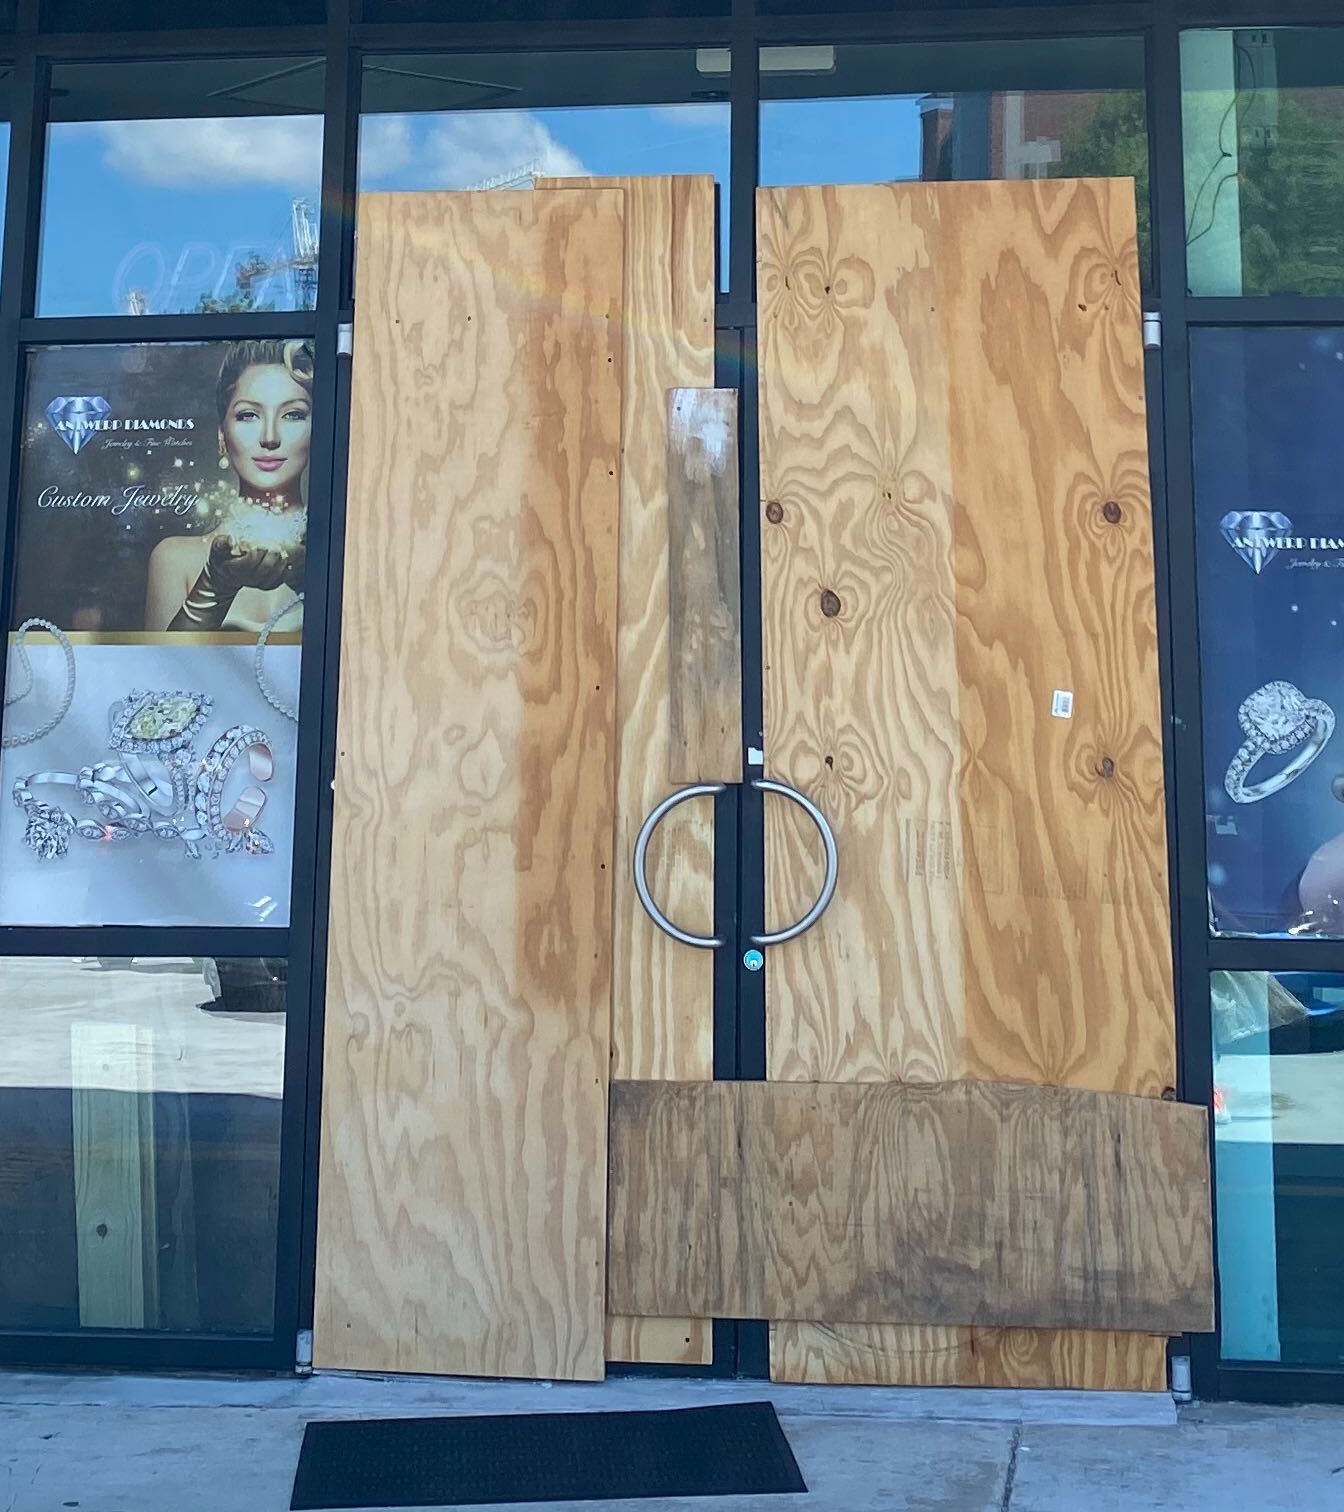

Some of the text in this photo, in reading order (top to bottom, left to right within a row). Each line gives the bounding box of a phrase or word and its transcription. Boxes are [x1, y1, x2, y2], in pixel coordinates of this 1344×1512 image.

[56, 418, 195, 431] ANTWERP DIAMONDS
[37, 484, 199, 516] Custom Jewelry
[1232, 537, 1306, 550] ANTWERP
